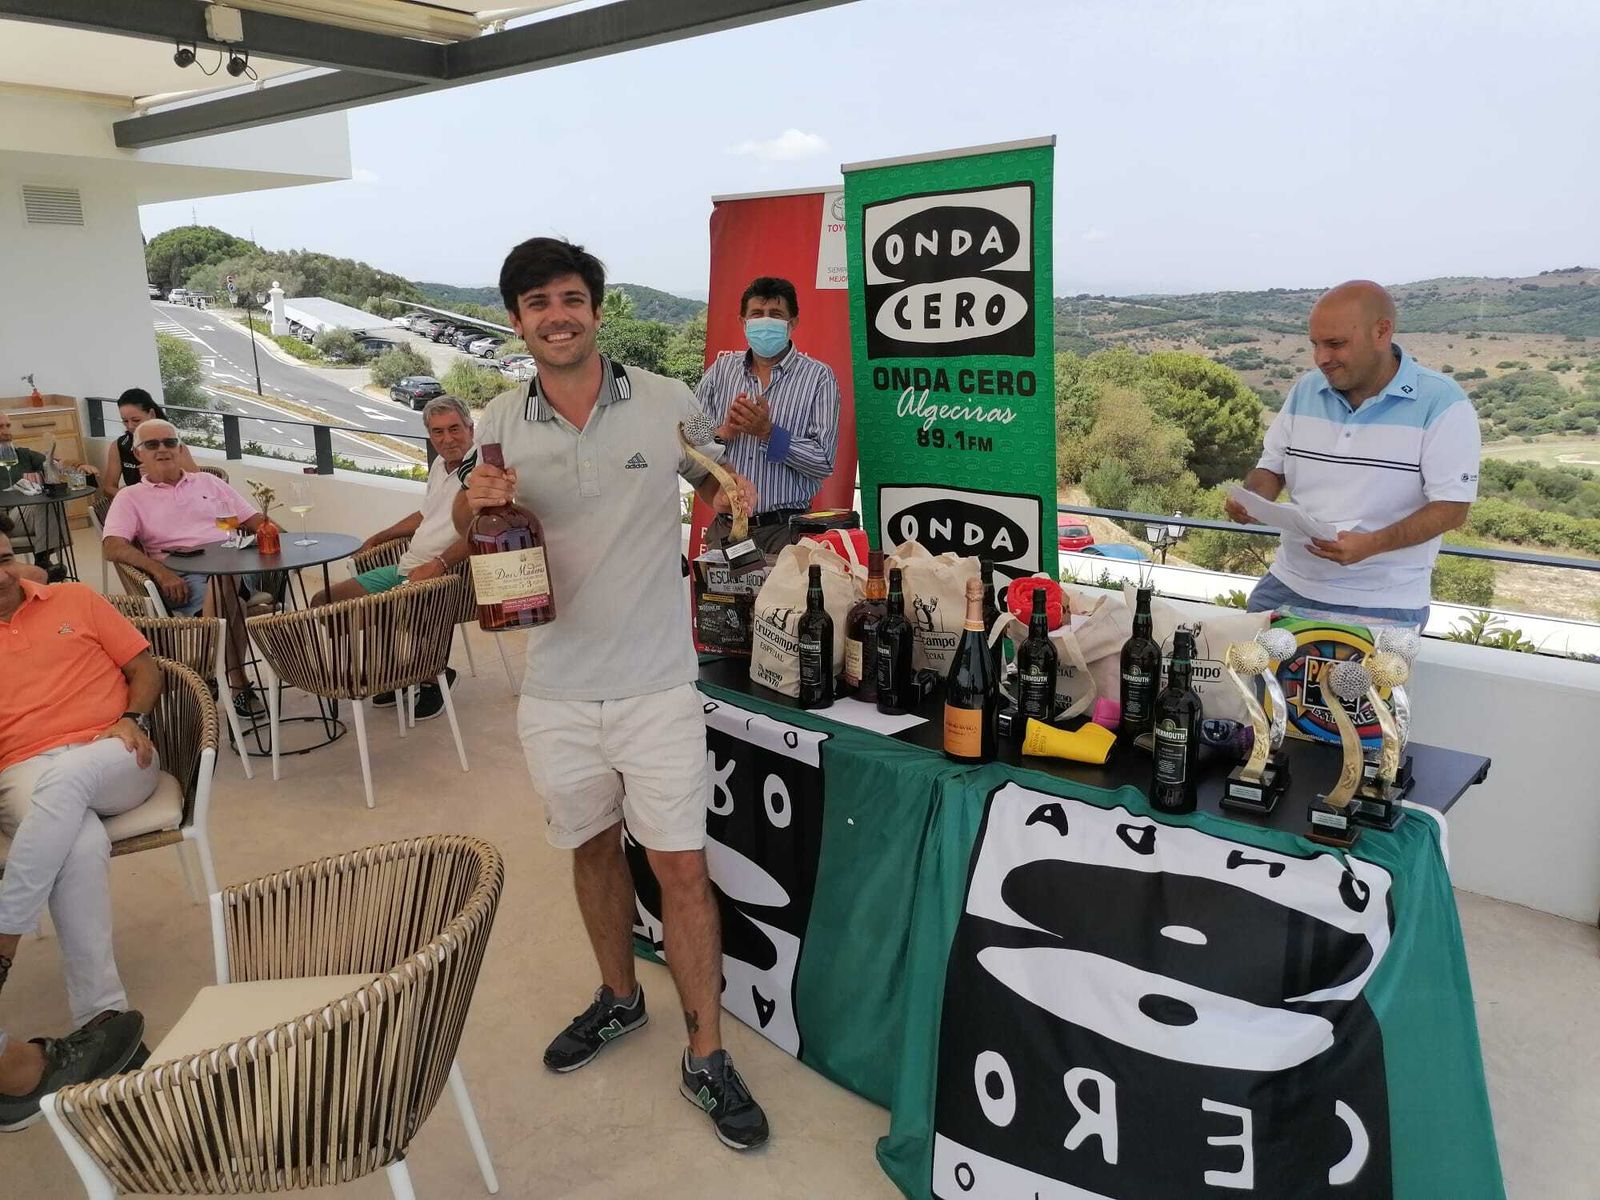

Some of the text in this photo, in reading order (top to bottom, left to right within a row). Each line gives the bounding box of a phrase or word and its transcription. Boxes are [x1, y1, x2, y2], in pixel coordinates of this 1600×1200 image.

[885, 225, 1004, 265] ONDA
[827, 266, 848, 274] SIEMP
[894, 291, 1006, 330] CERO
[873, 366, 1037, 397] ONDA CERO
[896, 386, 1017, 432] Algeciras
[900, 514, 1014, 553] ONDA
[755, 620, 799, 653] Cruzcampo
[1122, 673, 1149, 683] VERMOUTH
[1155, 728, 1186, 740] VERMOUTH
